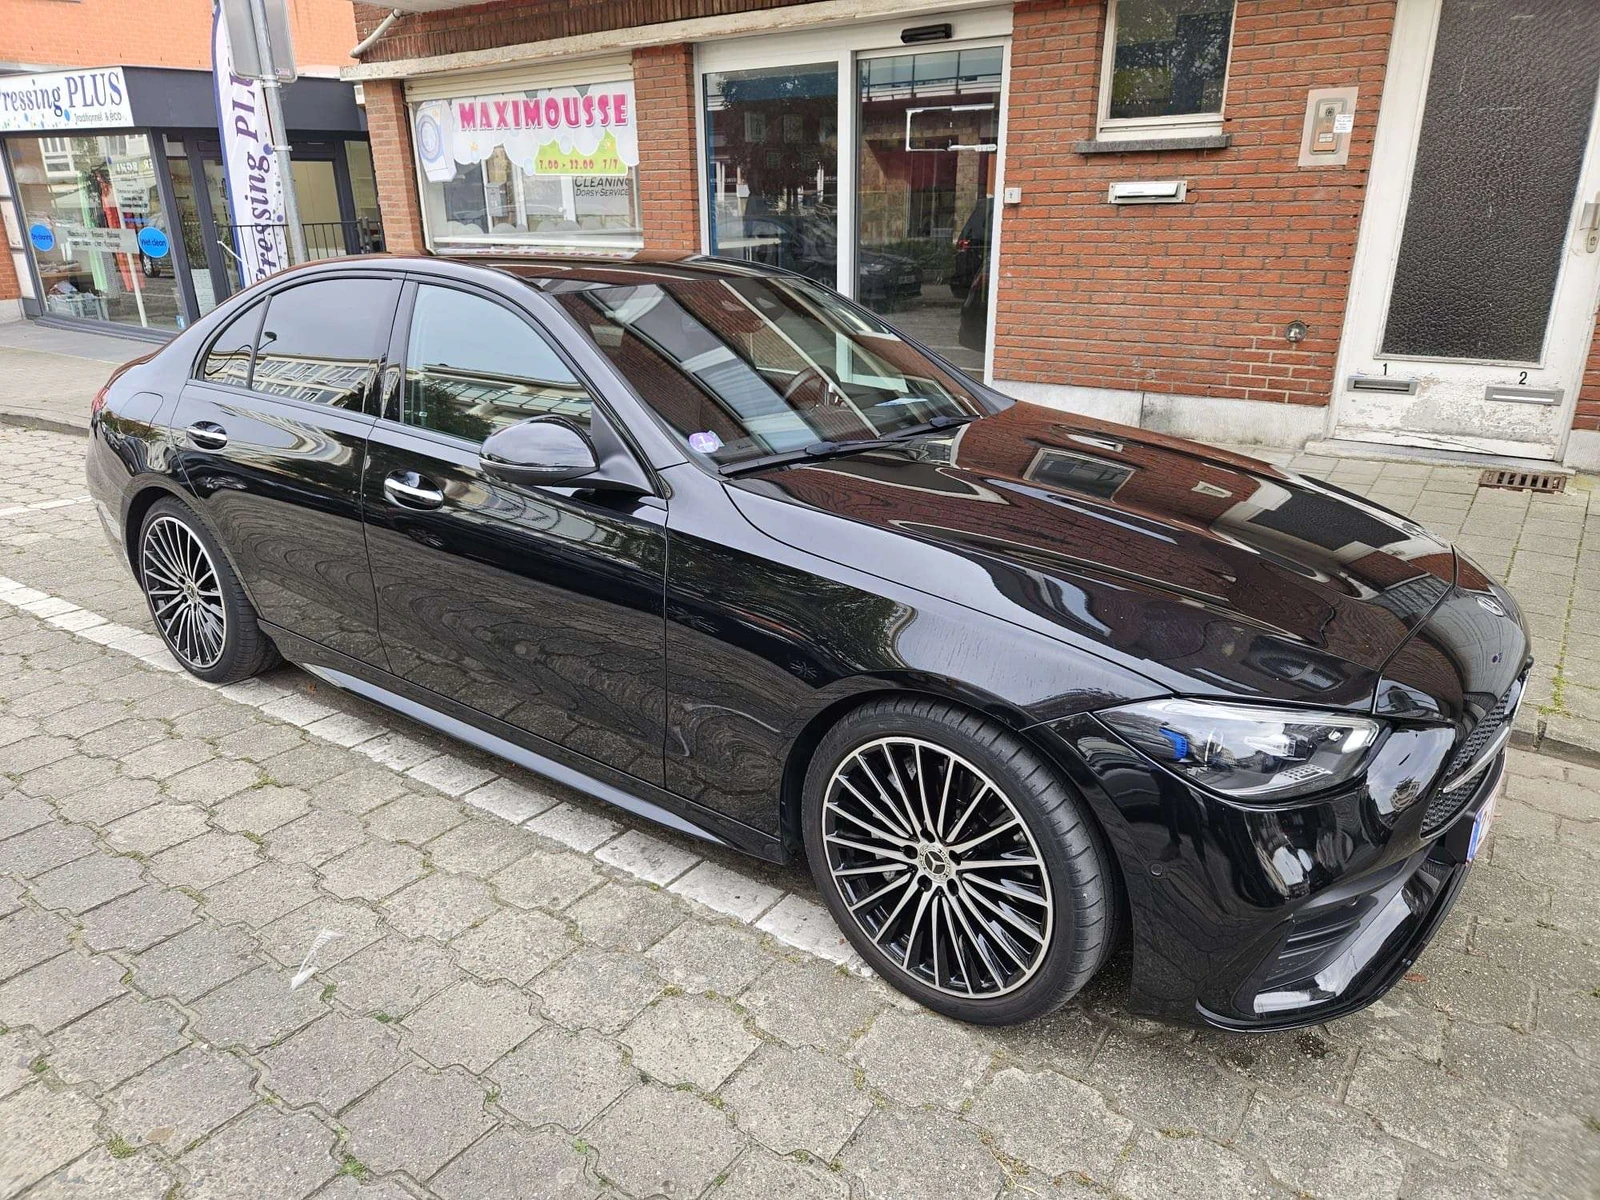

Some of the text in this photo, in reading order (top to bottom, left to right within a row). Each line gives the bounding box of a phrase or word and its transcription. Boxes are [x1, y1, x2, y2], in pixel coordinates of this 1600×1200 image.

[0, 71, 123, 118] ressing PLUS
[229, 72, 259, 143] PLU
[458, 93, 628, 130] MAXIMOUSSE
[539, 159, 559, 170] 7.00
[602, 159, 619, 170] 7/7
[1382, 362, 1389, 376] 1
[1518, 371, 1528, 385] 2
